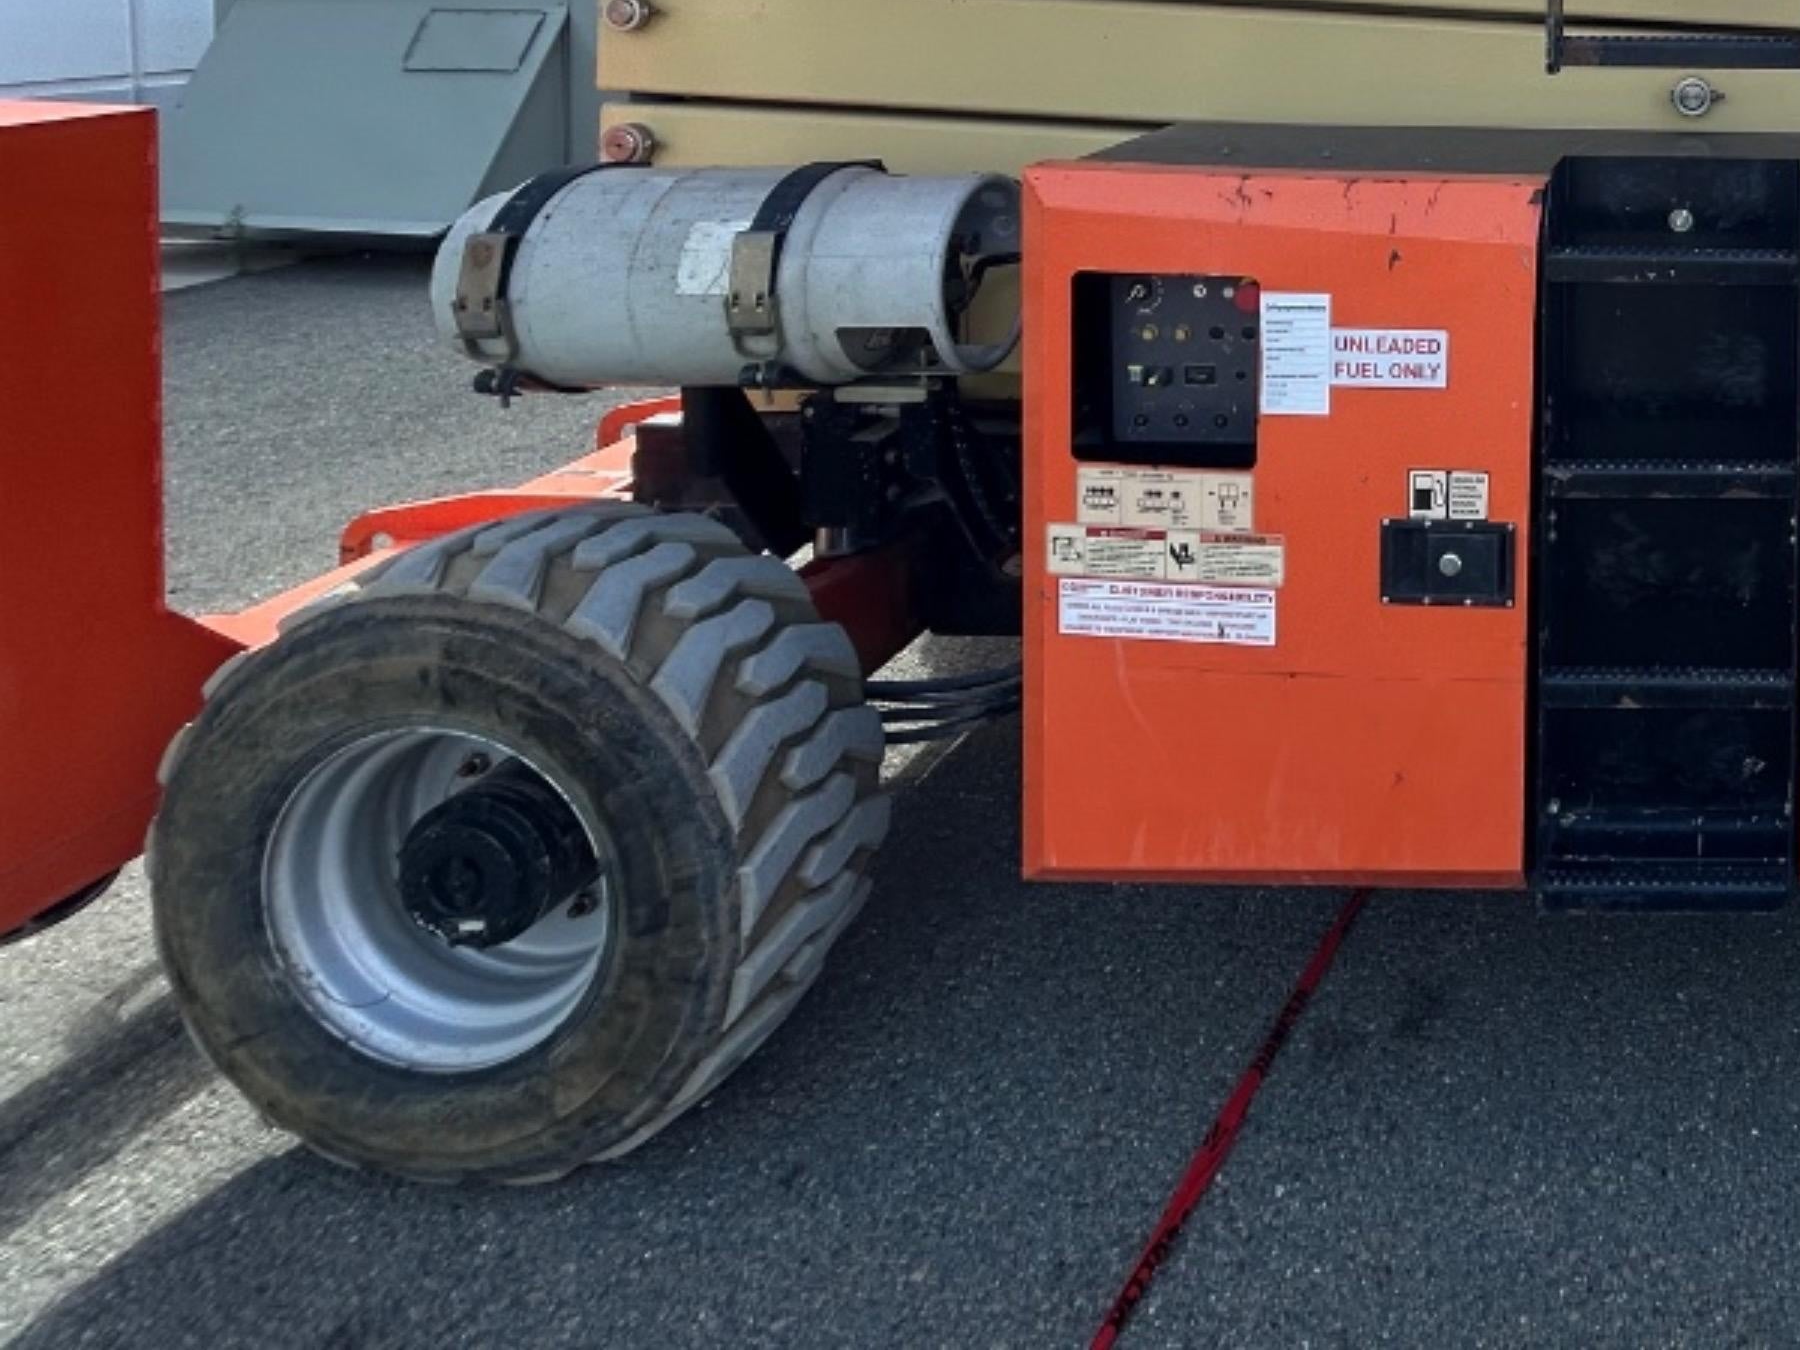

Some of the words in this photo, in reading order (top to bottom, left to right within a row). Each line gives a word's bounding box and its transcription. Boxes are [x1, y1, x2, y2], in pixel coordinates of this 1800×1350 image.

[1333, 335, 1441, 355] UNLEADED
[1333, 361, 1384, 380] FUEL
[1388, 362, 1441, 381] ONLY
